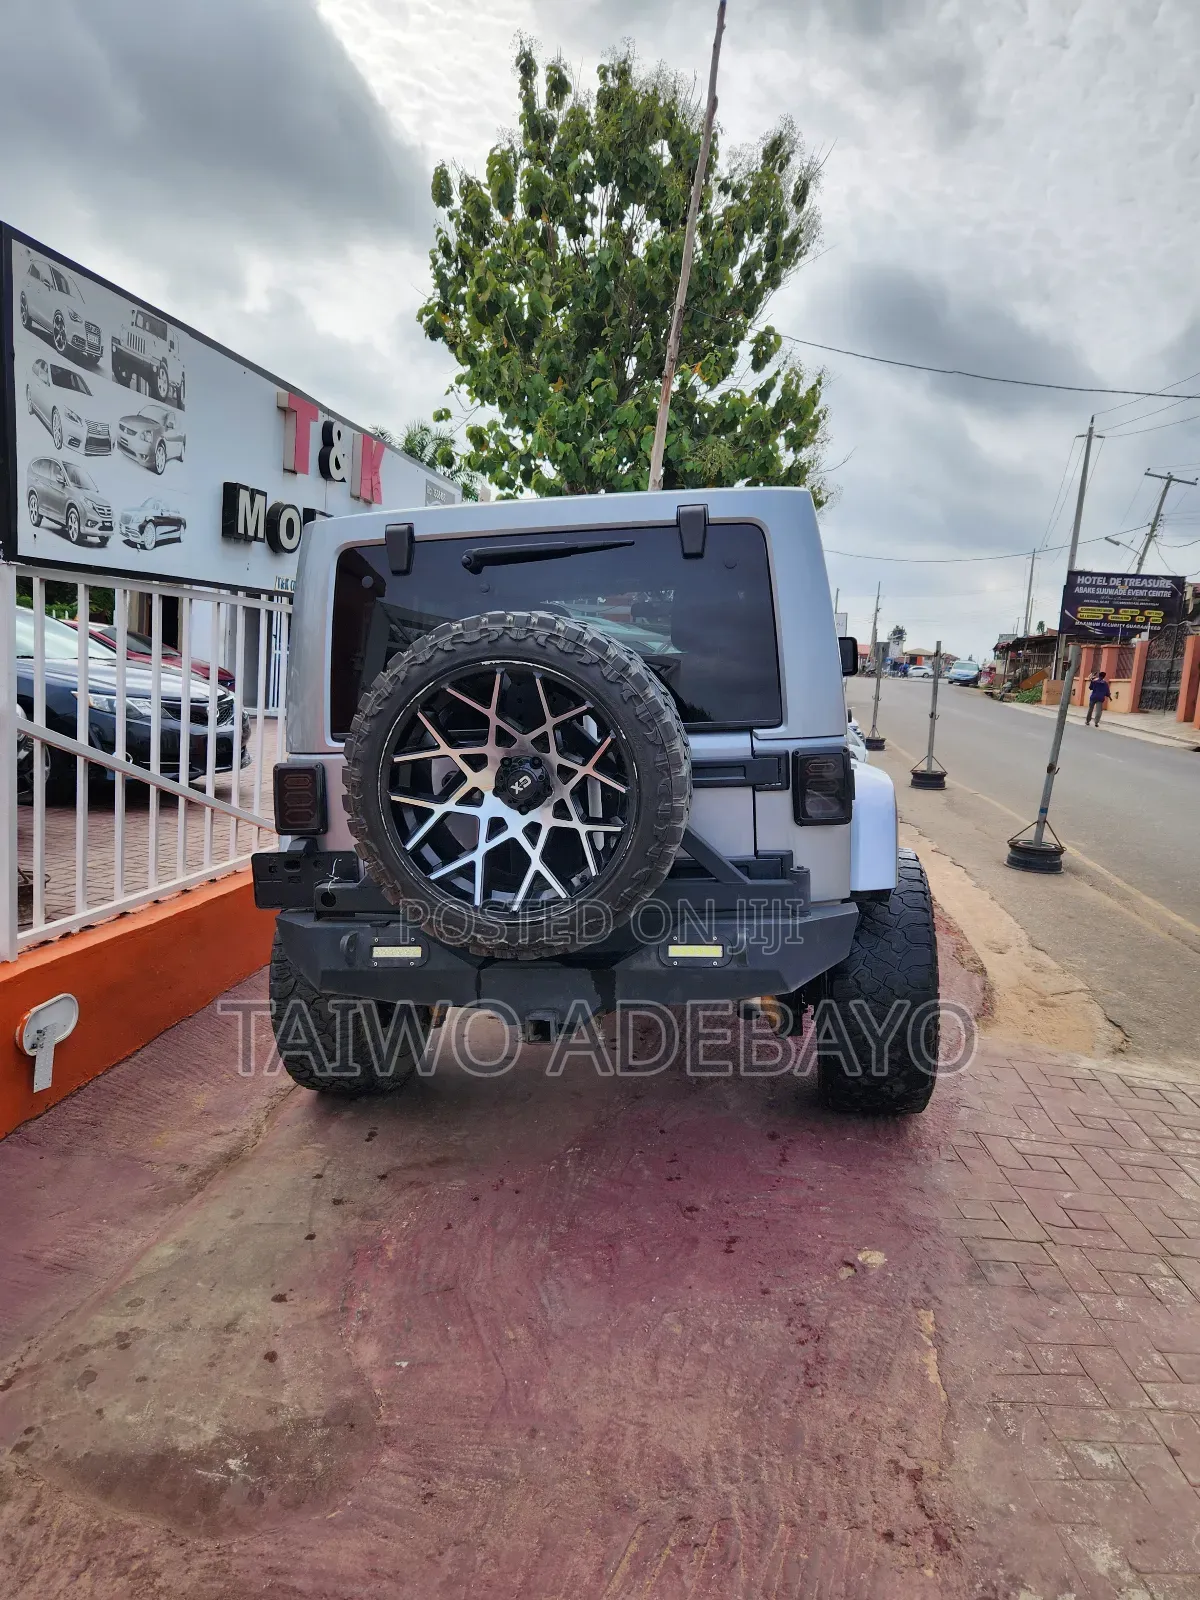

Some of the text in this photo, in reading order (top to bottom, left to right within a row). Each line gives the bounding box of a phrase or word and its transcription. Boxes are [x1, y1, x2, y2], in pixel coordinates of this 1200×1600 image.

[285, 392, 386, 505] T & K
[223, 483, 334, 554] MO
[1074, 586, 1096, 594] ABAKE
[1127, 588, 1148, 597] EVENT
[1148, 589, 1172, 598] CENTRE
[1077, 576, 1108, 585] HOTEL
[1109, 577, 1123, 586] DE
[1124, 578, 1172, 588] TREASURE
[509, 775, 532, 795] XD
